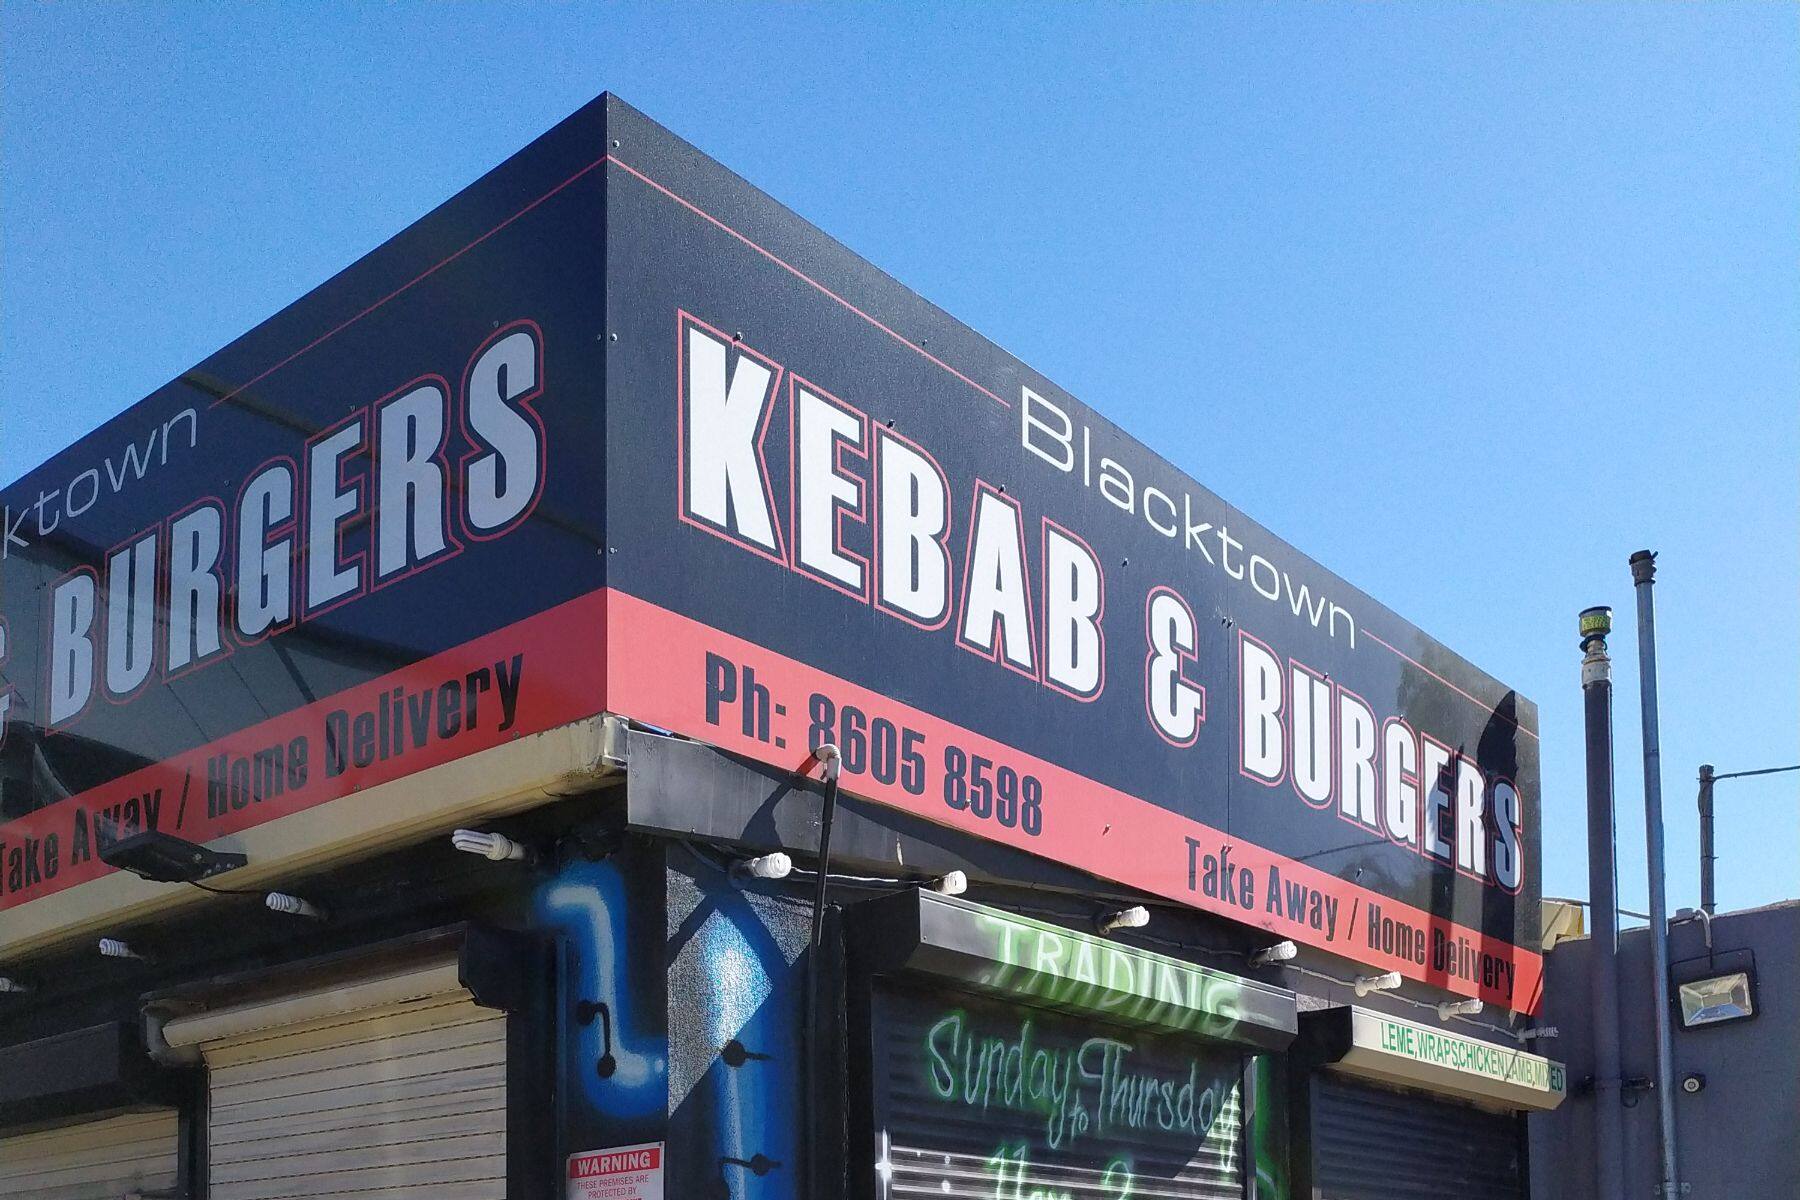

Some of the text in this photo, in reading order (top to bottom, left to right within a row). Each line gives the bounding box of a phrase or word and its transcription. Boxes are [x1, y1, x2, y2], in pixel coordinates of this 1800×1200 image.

[2, 406, 197, 560] ktown
[50, 331, 539, 727] BURGERS
[1021, 385, 1356, 650] Blacktown
[686, 324, 1522, 890] KEBAB & BURGERS
[206, 731, 309, 820] Home
[325, 651, 524, 779] Delivery
[705, 650, 1043, 837] Ph: 8605 8598
[976, 914, 1243, 1036] TRADING
[1184, 836, 1255, 911] Take
[1265, 865, 1339, 942] Away
[1368, 902, 1426, 966] Home
[1432, 926, 1517, 1001] Delivery
[928, 1015, 1072, 1150] Sunday
[1068, 1088, 1090, 1143] to
[576, 1174, 649, 1190] THESE PREMISES ARE
[577, 1151, 651, 1176] WARNING
[587, 1186, 638, 1200] PROTECTED BY
